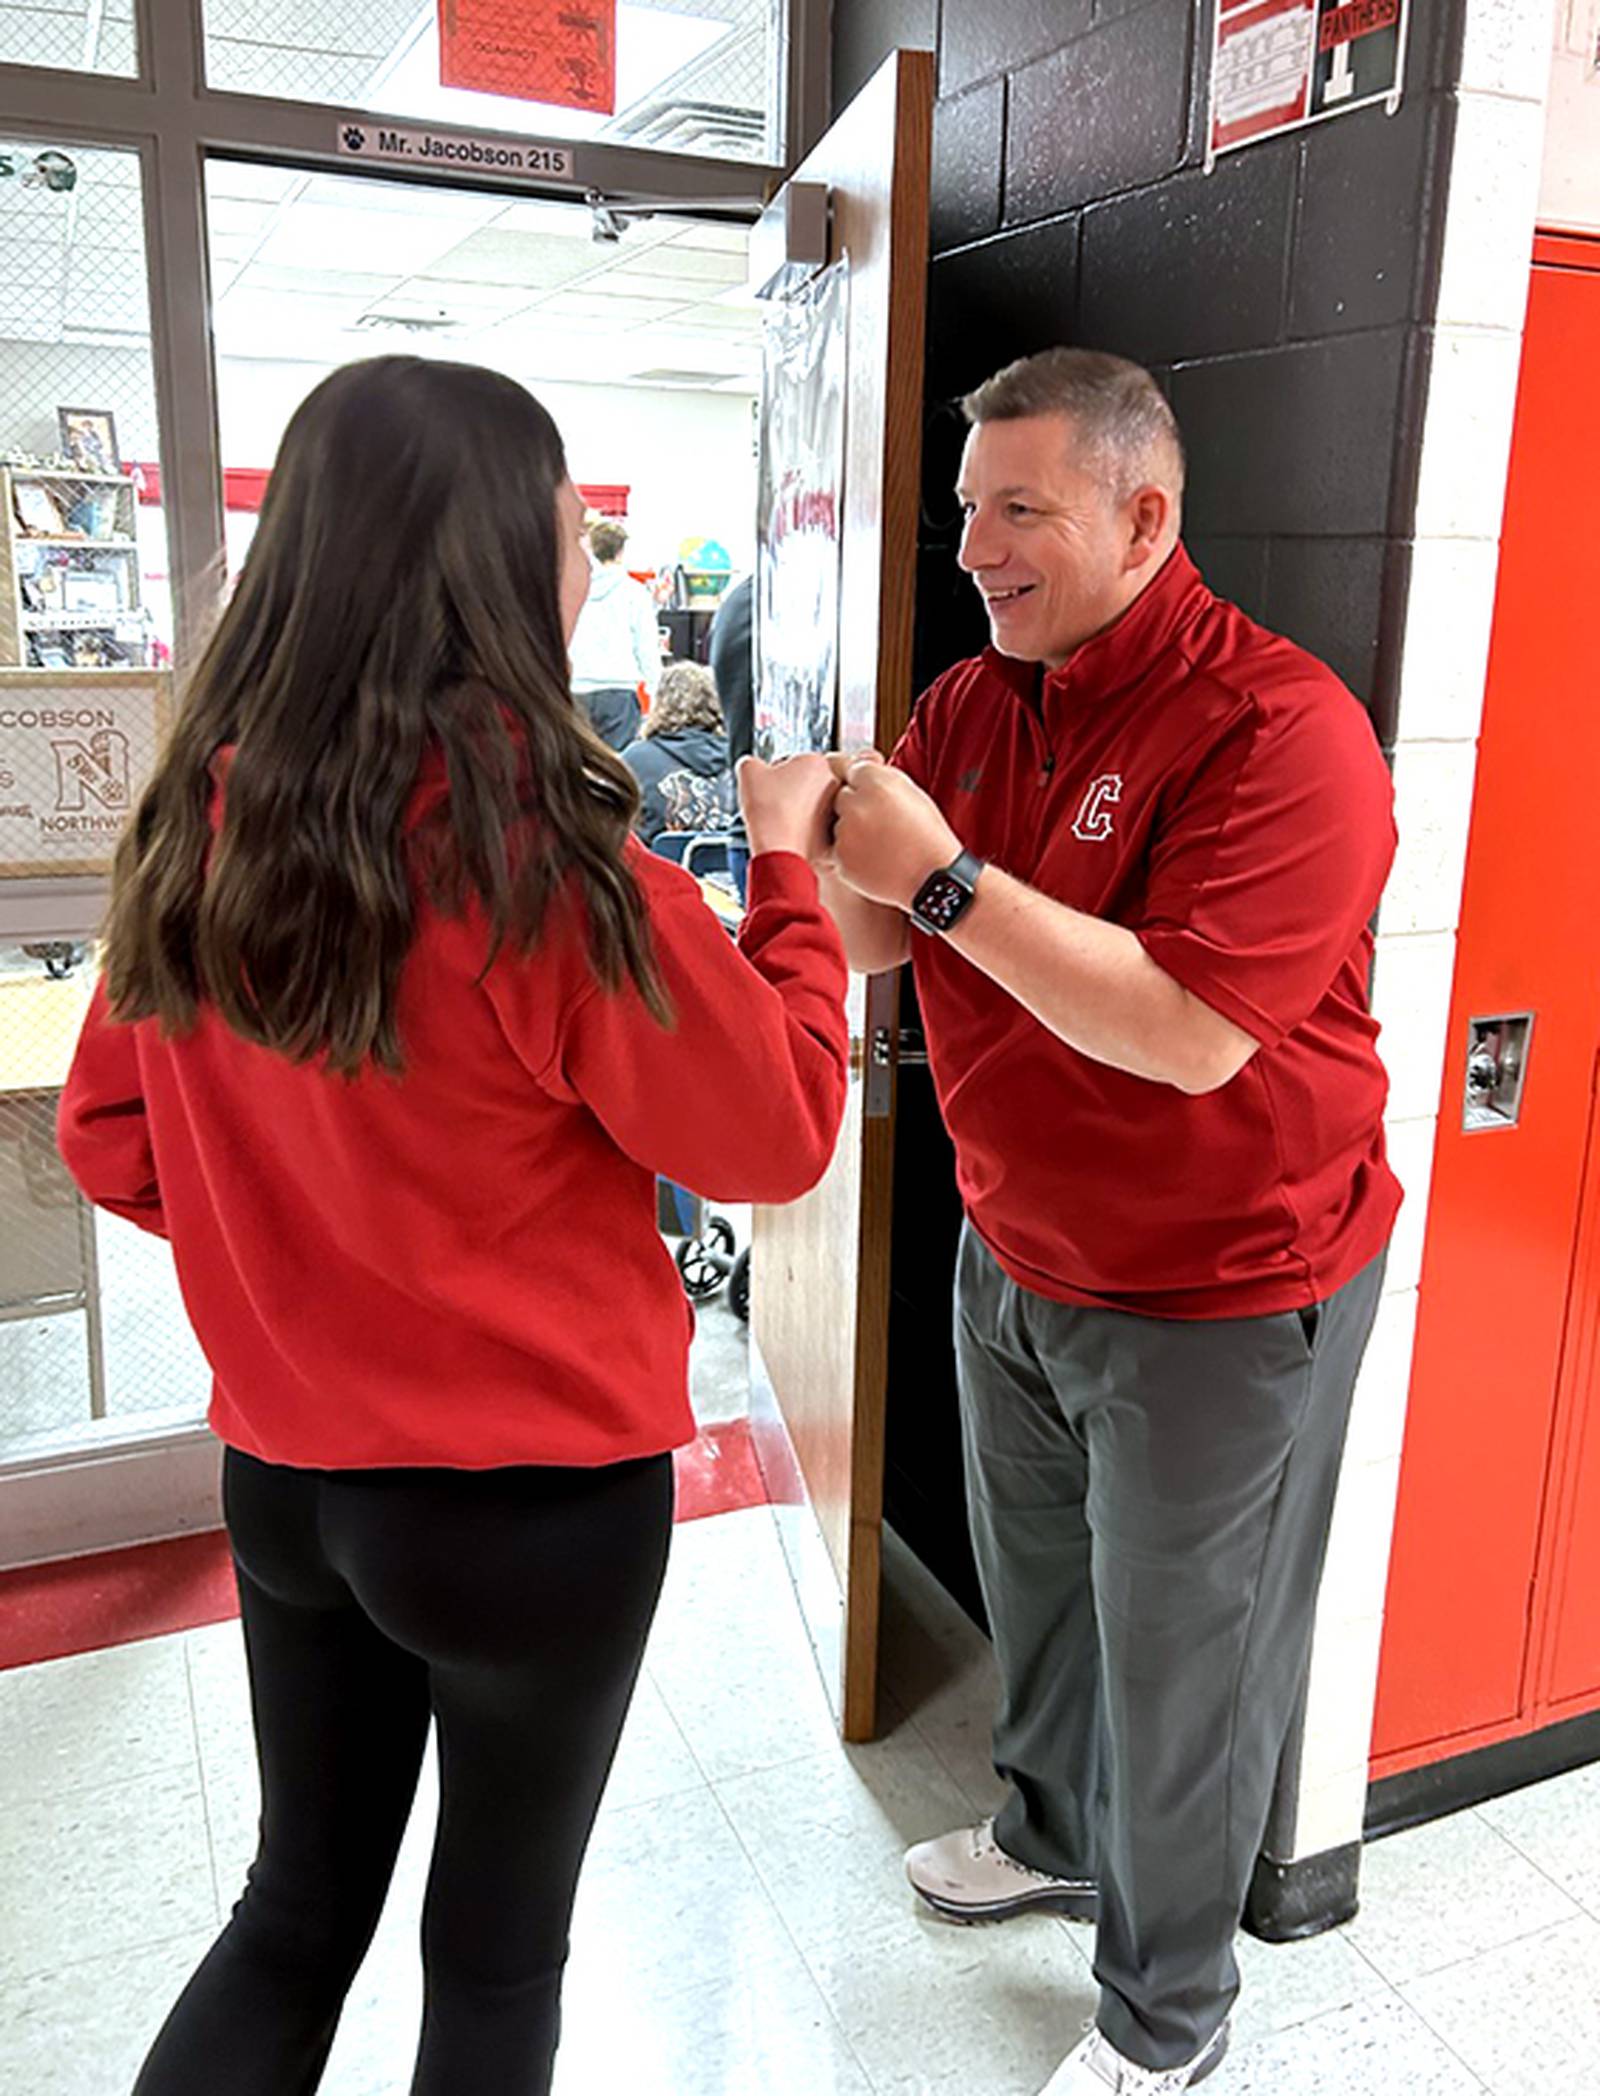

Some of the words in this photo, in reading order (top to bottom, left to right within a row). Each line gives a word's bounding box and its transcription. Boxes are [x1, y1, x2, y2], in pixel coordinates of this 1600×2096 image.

[379, 131, 412, 153] Mr.
[418, 136, 523, 167] Jacobson
[527, 150, 565, 172] 215
[0, 710, 114, 728] COBSON
[1072, 774, 1123, 840] C
